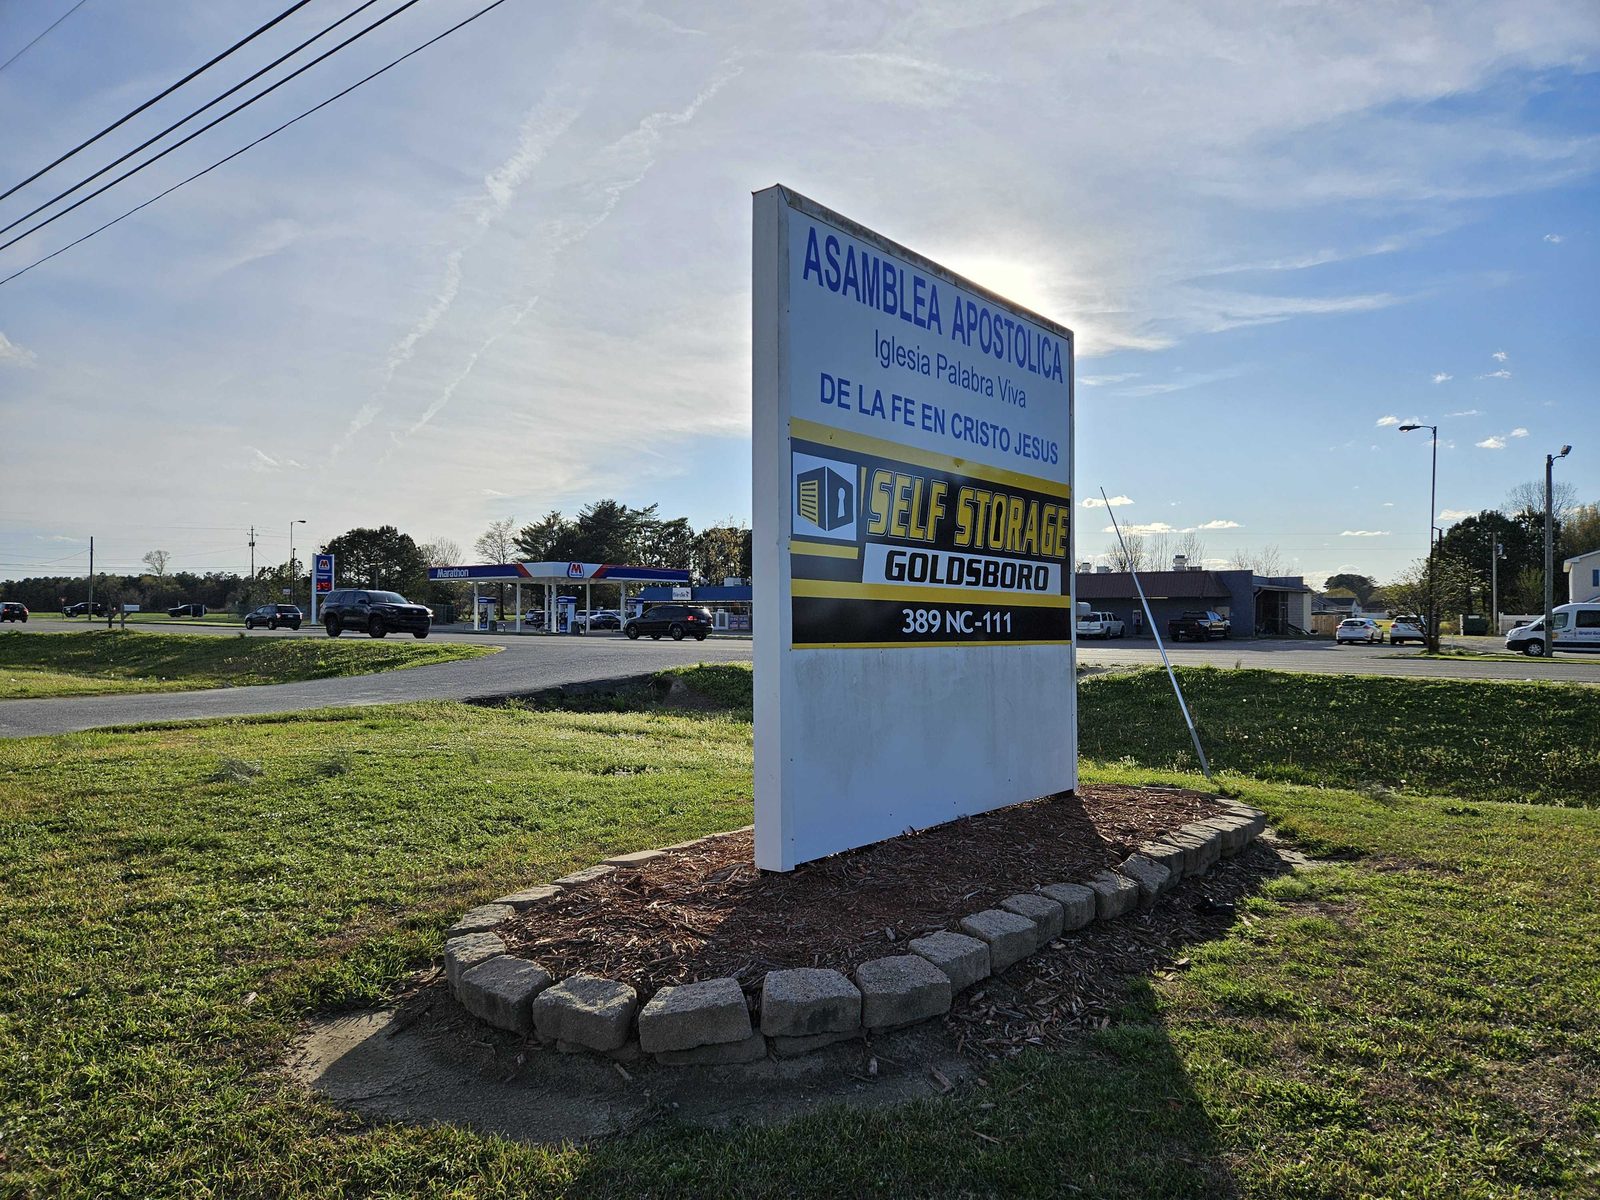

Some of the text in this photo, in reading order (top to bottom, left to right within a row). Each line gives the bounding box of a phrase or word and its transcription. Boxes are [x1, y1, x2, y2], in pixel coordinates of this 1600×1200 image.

[803, 226, 1063, 384] ASAMBLEA APOSTOLICA
[875, 329, 1026, 408] Iglesia Palabra Viva
[820, 372, 1058, 464] DE LA FE EN CRISTO JESUS
[866, 468, 1069, 559] SELF STORAGE
[437, 568, 469, 578] Marathon
[885, 550, 1049, 591] GOLDSBORO
[902, 608, 1012, 633] 389 NC-111
